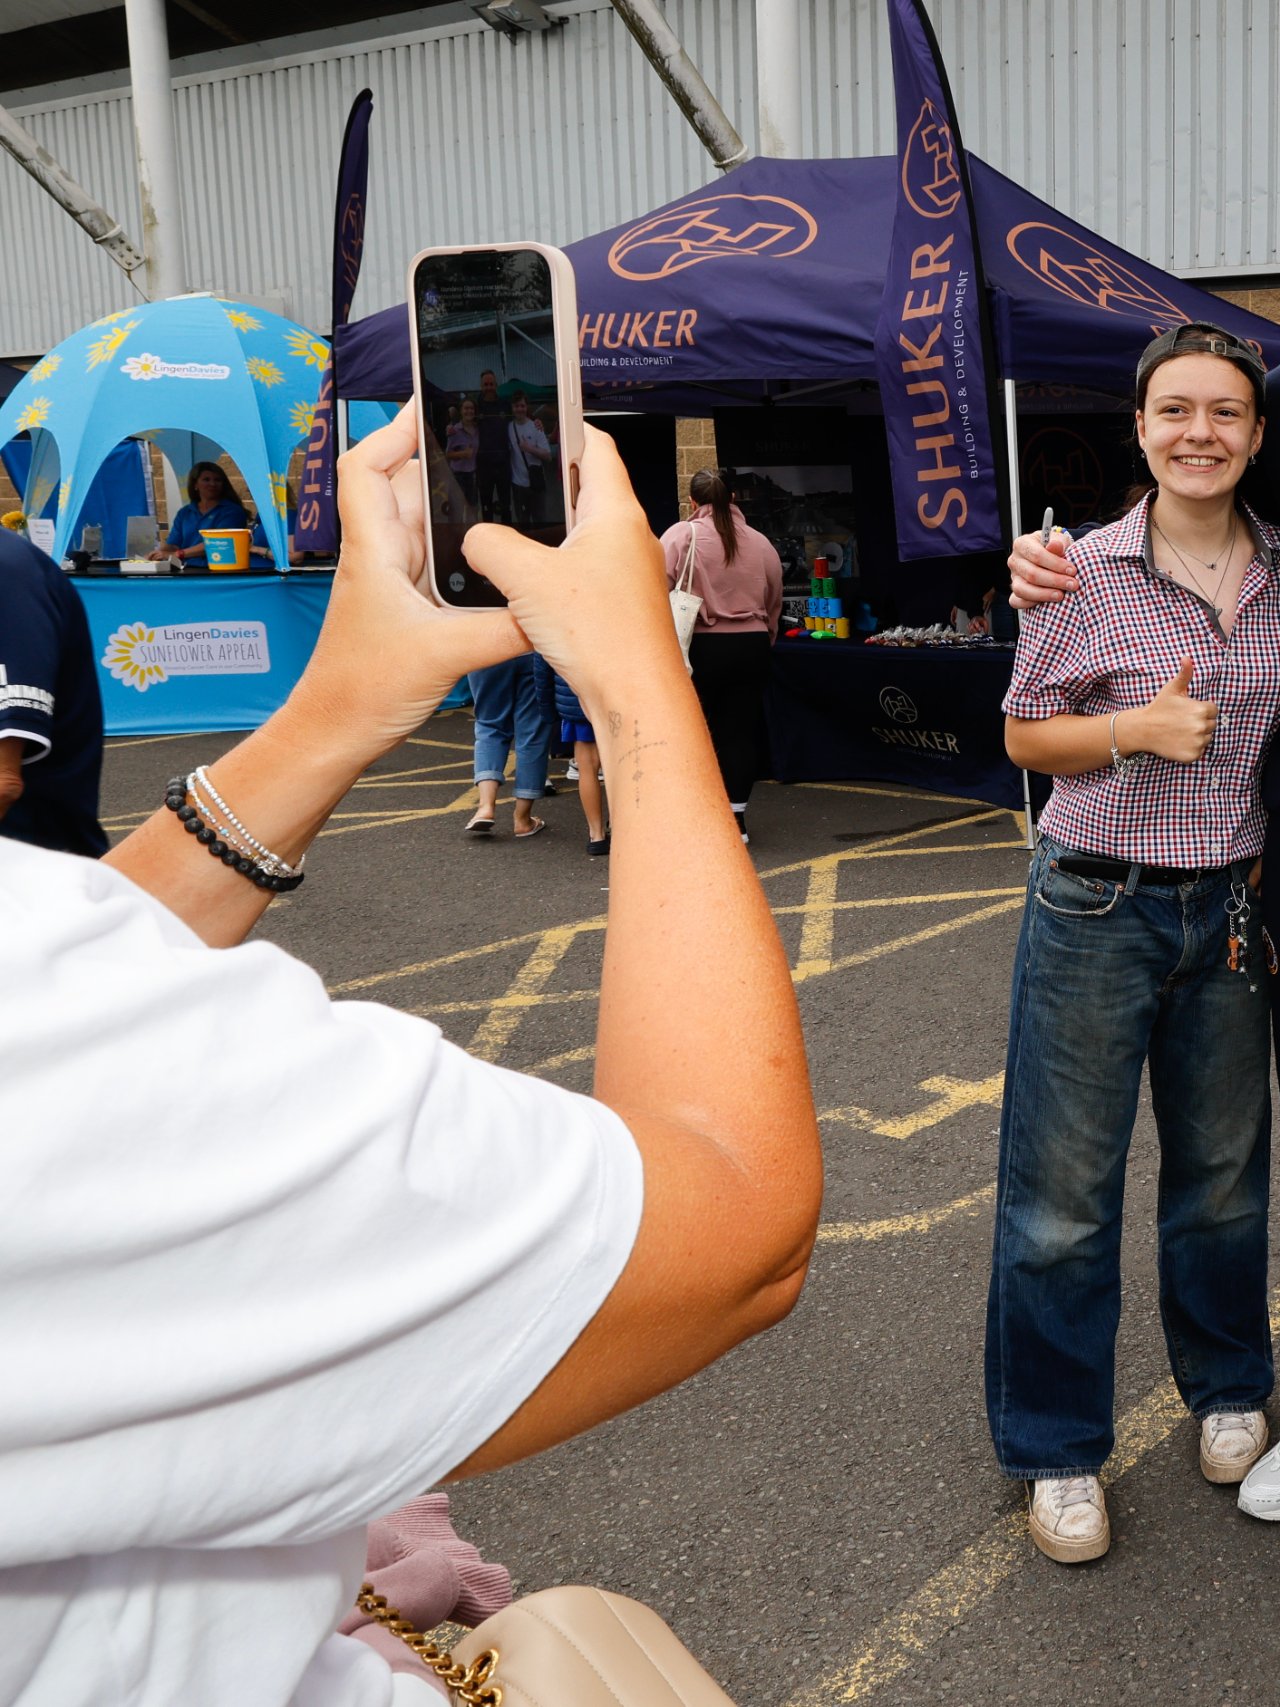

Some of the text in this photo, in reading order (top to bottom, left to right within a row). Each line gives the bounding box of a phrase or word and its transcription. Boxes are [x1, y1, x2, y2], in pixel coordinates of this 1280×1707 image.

[578, 309, 698, 349] HUKER
[154, 364, 225, 374] LingenDavies
[580, 356, 674, 367] UILDING & DEVELOPMENT
[953, 270, 979, 478] BUILDING & DEVELOPMENT
[899, 233, 968, 529] SHUKER
[164, 628, 259, 642] LingenDavies
[139, 642, 262, 664] SUNFLOWER APPEAL
[871, 726, 961, 754] SHUKER
